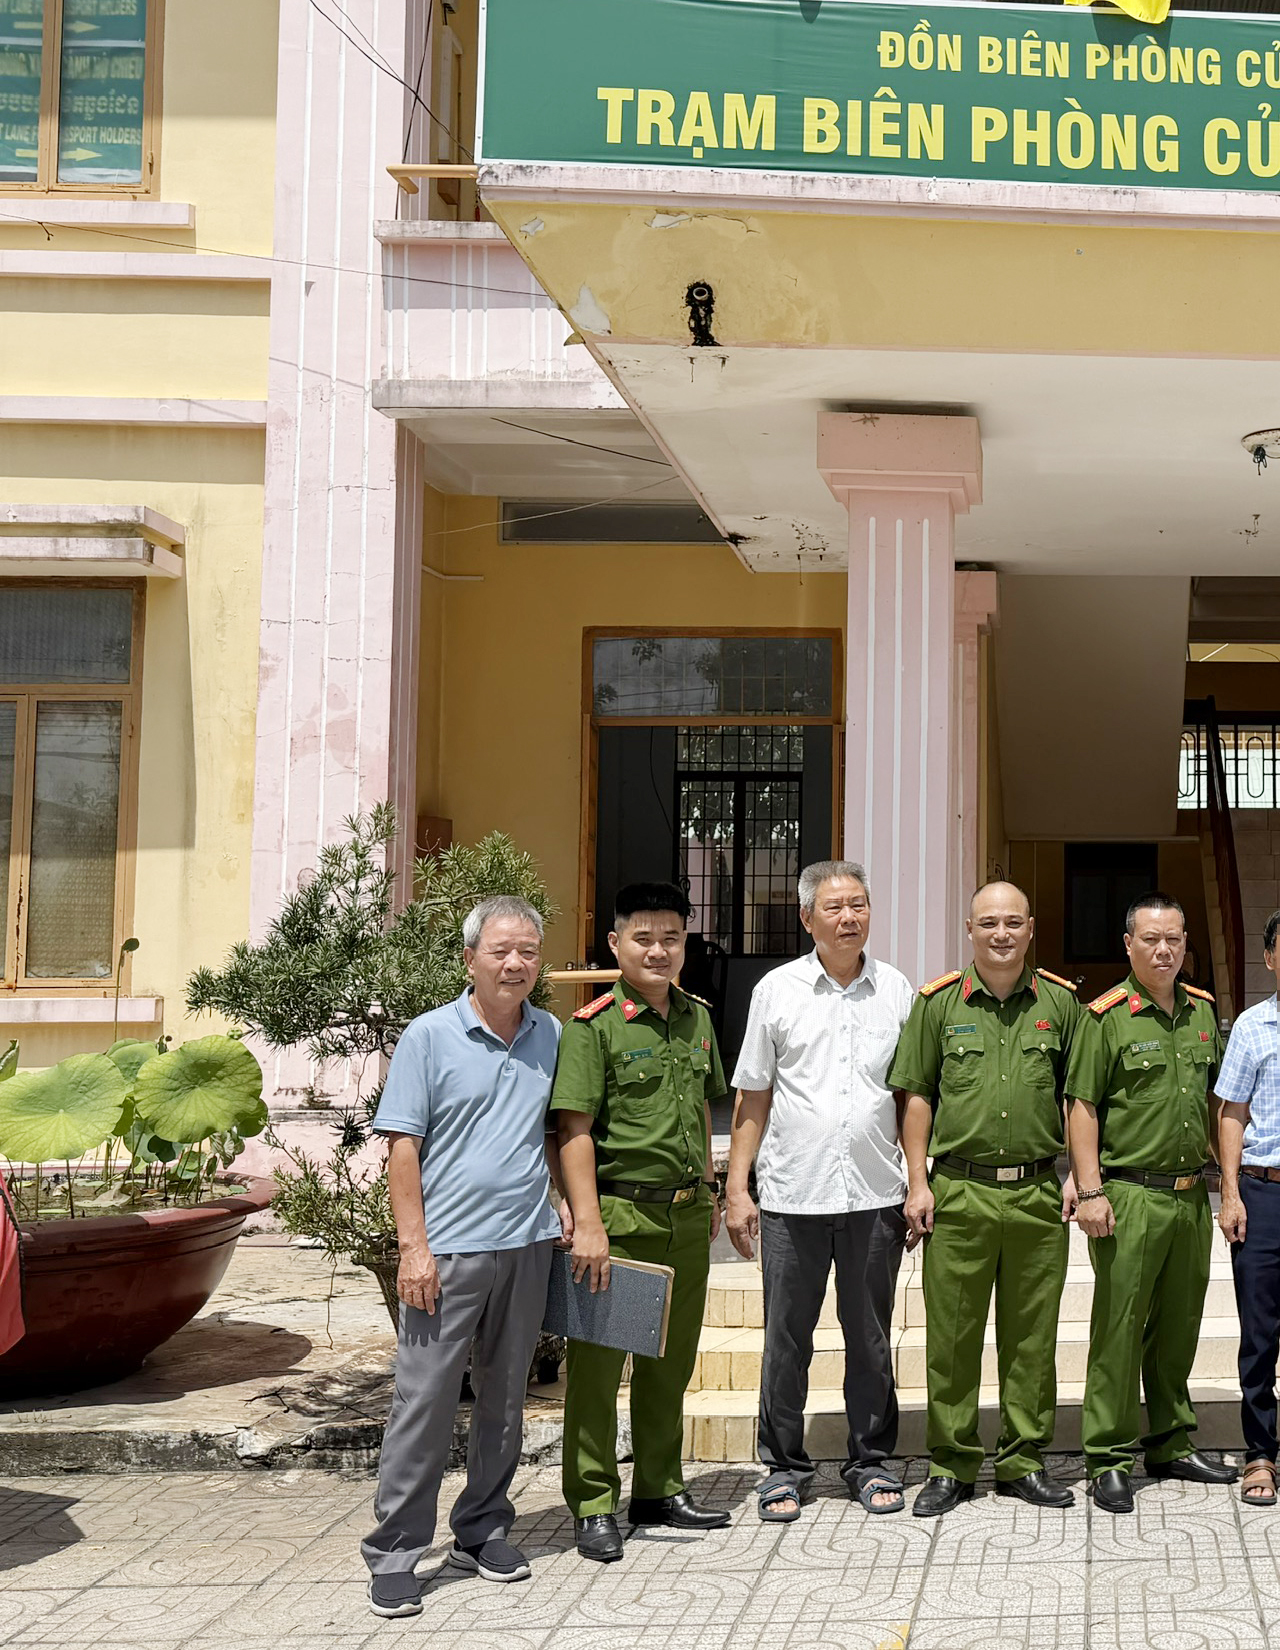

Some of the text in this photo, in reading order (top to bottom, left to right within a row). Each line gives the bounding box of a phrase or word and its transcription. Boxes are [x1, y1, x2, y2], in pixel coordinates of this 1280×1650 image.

[876, 18, 962, 72] ĐỒN
[978, 30, 1071, 79] BIÊN
[1084, 35, 1222, 86] PHÒNG
[100, 126, 142, 146] HOLDERS
[597, 87, 776, 159] TRẠM
[803, 87, 945, 162] BIÊN
[971, 97, 1181, 174] PHÒNG
